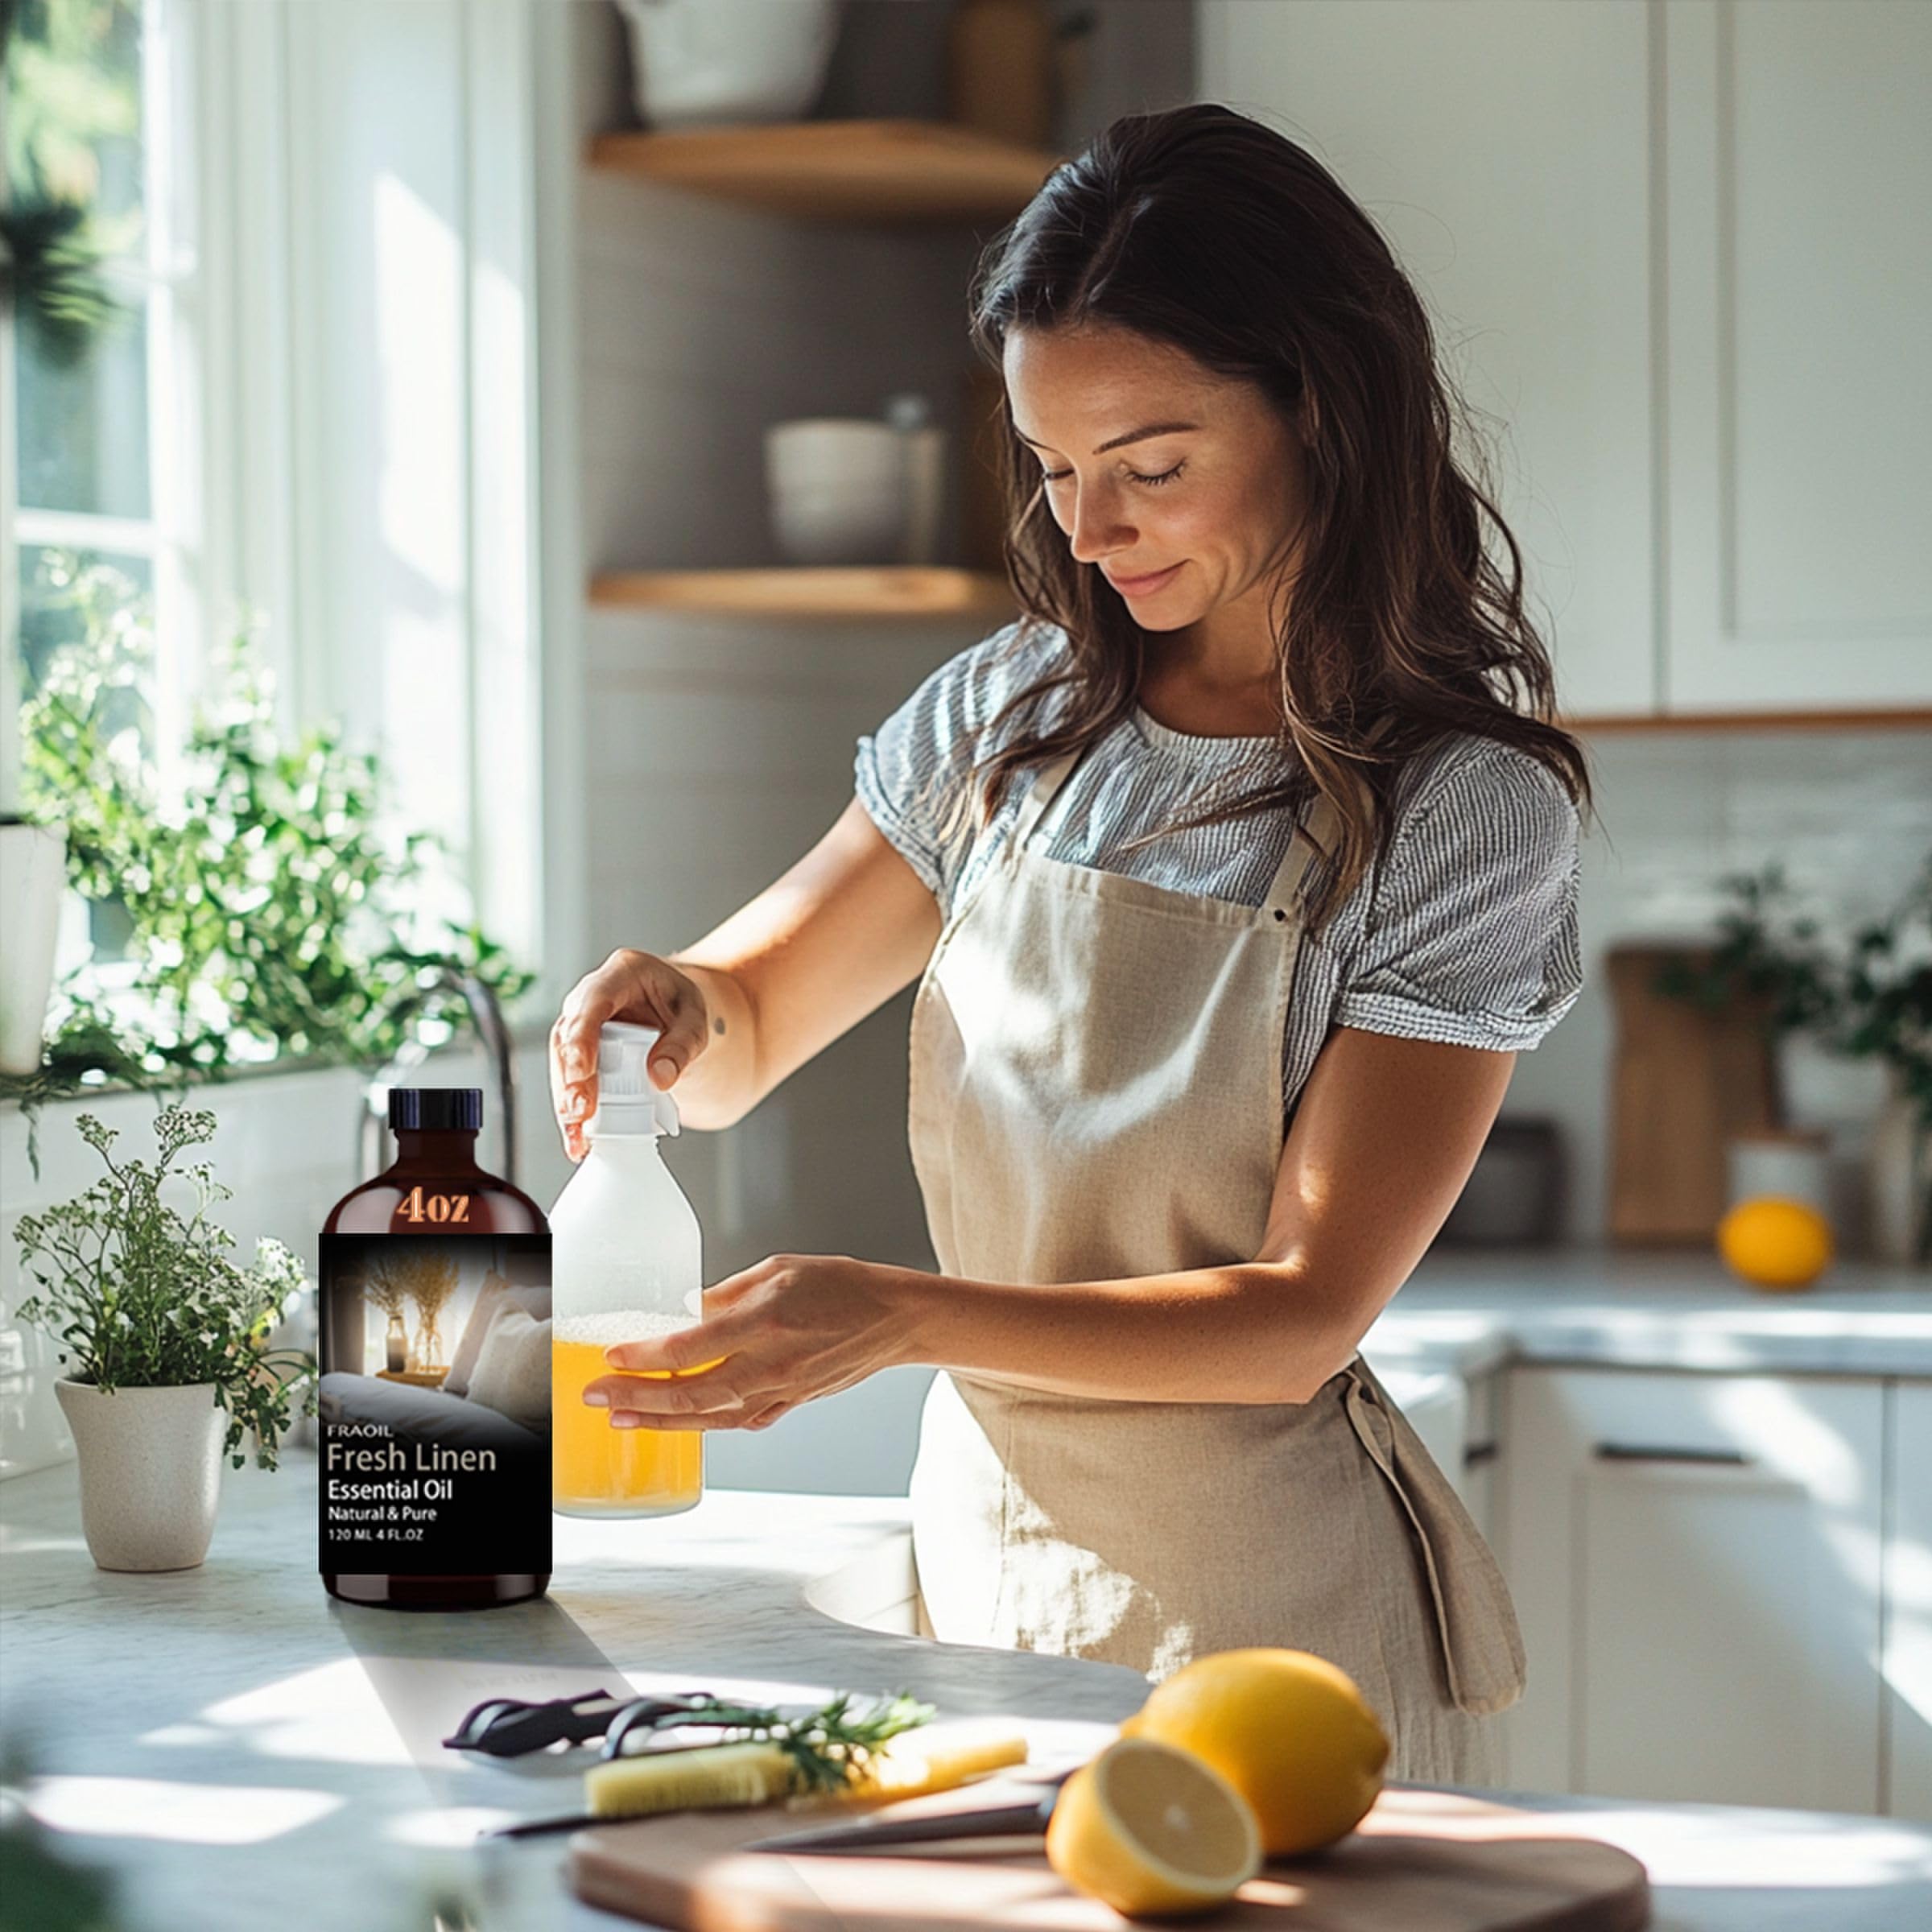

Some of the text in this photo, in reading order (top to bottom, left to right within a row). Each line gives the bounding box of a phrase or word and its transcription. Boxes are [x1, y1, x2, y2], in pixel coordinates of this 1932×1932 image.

[396, 1186, 469, 1223] 4oz
[327, 1424, 393, 1438] FRAOIL
[327, 1443, 496, 1471] Fresh Linen
[328, 1480, 452, 1500] Essential Oil
[328, 1506, 437, 1521] Natural & Pure
[328, 1530, 351, 1540] 120
[354, 1530, 373, 1540] ML
[376, 1530, 385, 1540] 4
